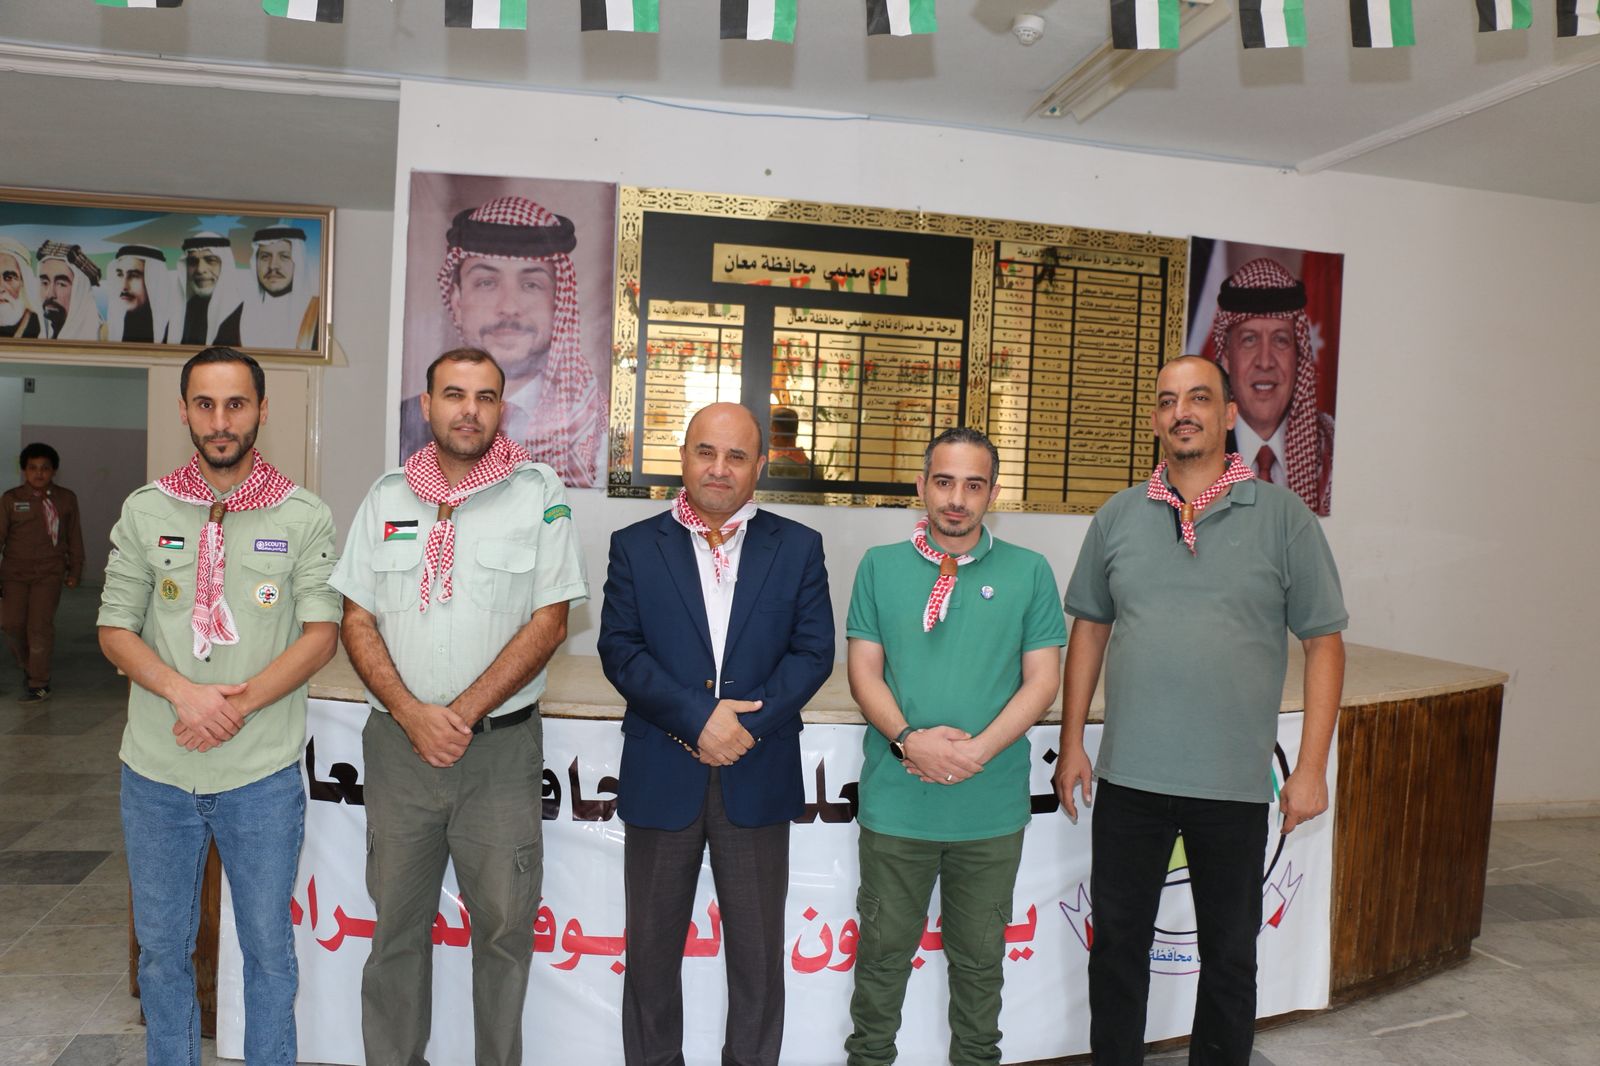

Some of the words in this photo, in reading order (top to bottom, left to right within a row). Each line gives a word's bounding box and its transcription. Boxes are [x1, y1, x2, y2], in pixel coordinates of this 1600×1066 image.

[724, 253, 757, 275] معان
[761, 254, 816, 275] محافظة
[1103, 254, 1121, 266] شرف
[868, 263, 898, 288] نادي
[786, 312, 807, 325] معان
[809, 312, 843, 325] محافظة
[915, 319, 933, 334] شرف
[936, 320, 956, 336] لوحة
